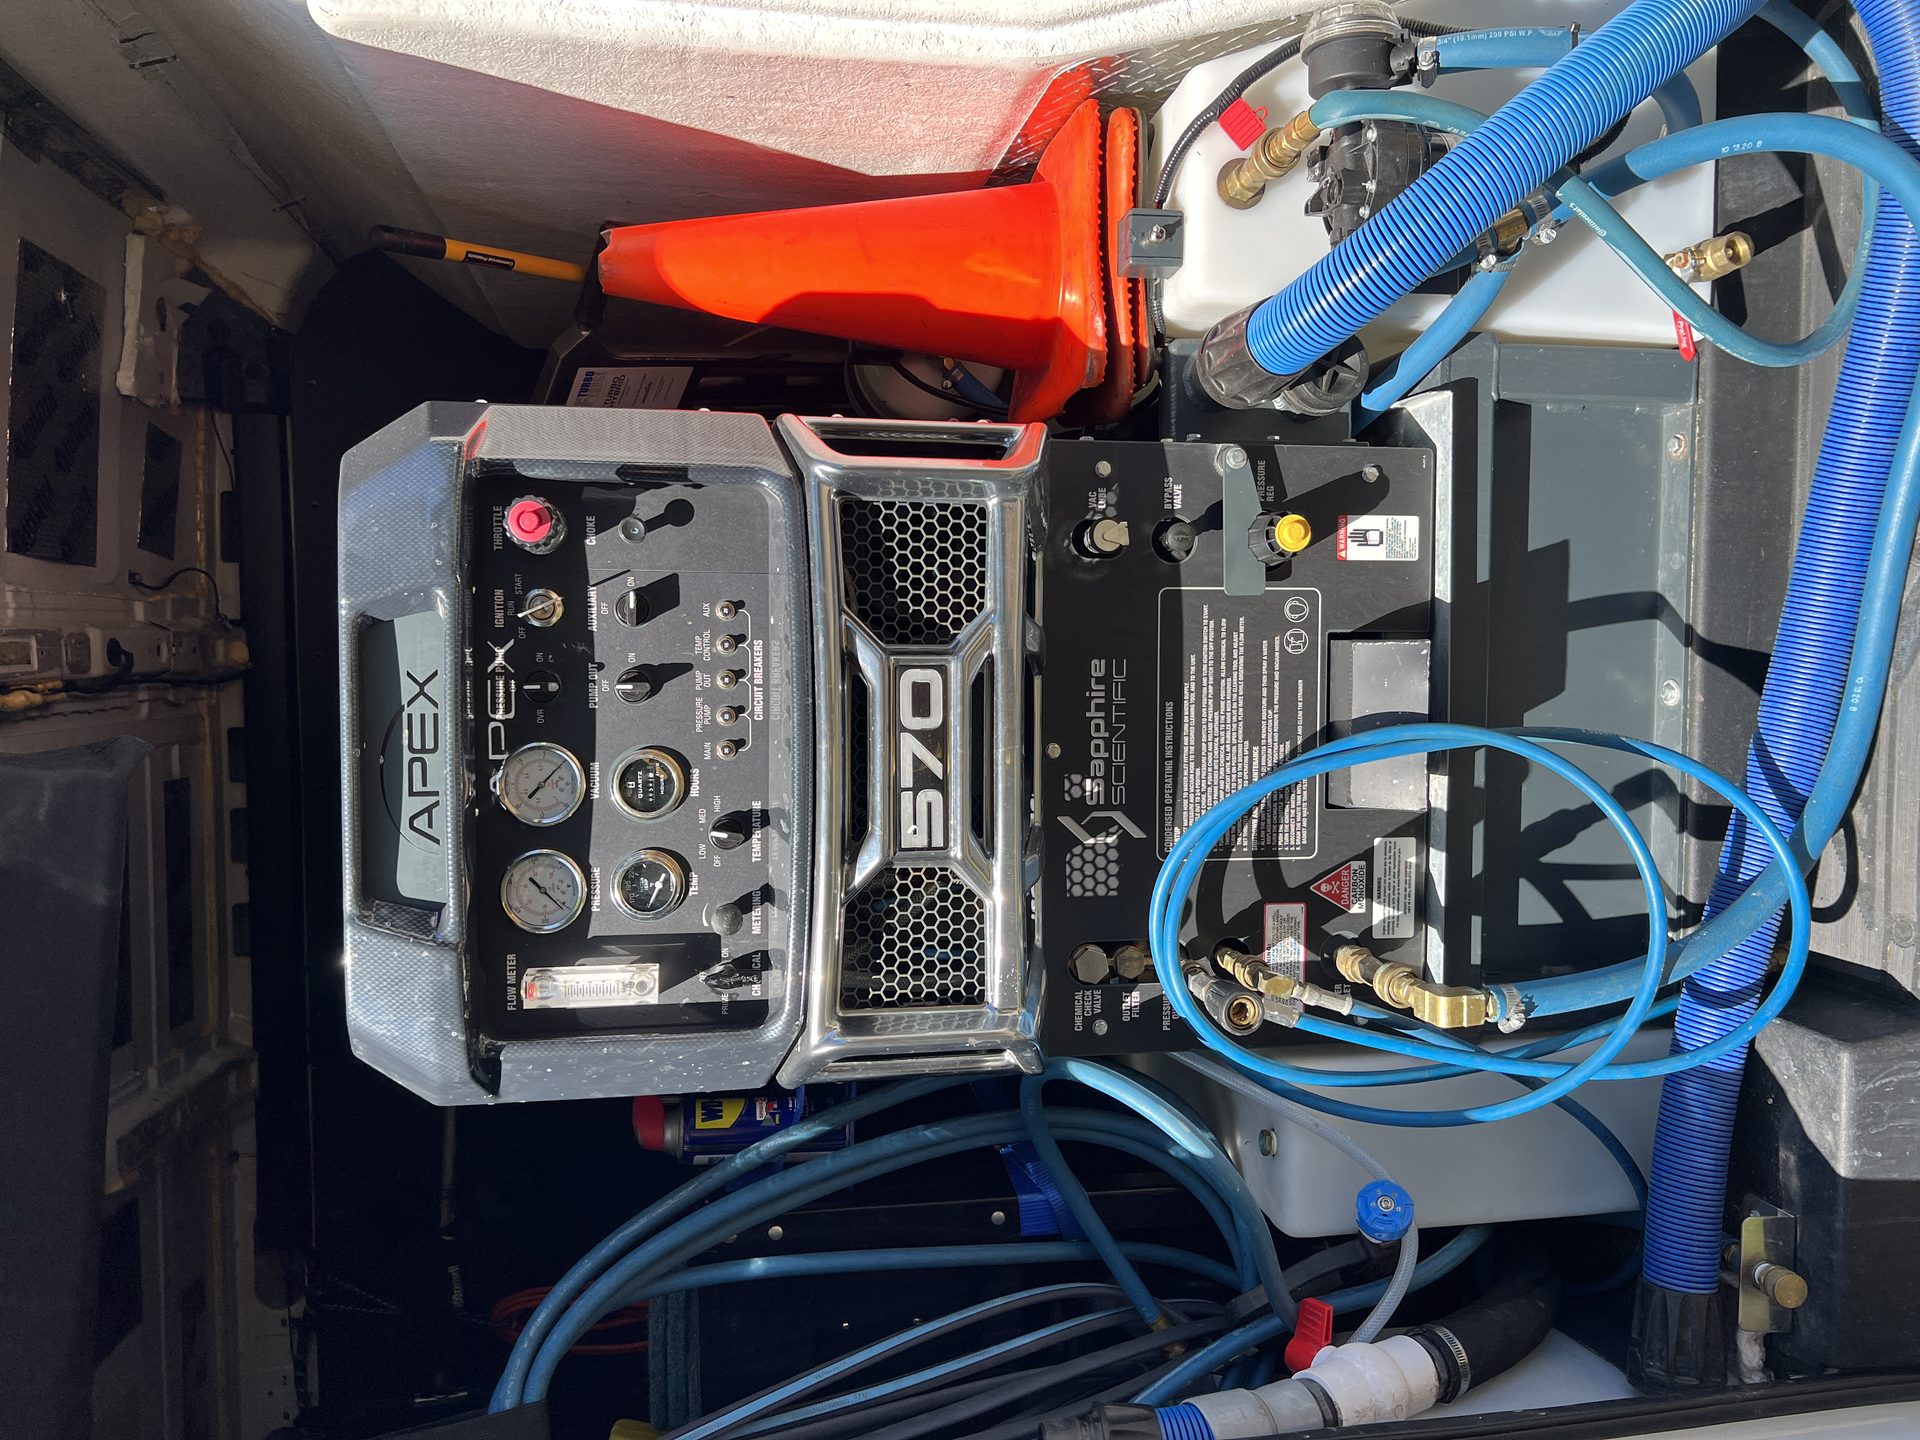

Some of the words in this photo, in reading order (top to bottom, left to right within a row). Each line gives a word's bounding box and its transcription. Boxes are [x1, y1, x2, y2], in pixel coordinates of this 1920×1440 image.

[1489, 30, 1502, 38] 200
[578, 371, 595, 398] TURBO
[603, 376, 619, 406] TURBO
[1164, 477, 1173, 509] BYPASS
[1257, 460, 1266, 501] PRESSURE
[1266, 485, 1274, 502] REG
[1088, 491, 1097, 508] VAC
[1098, 487, 1106, 509] LUBE
[1173, 484, 1182, 509] VALVE
[493, 505, 503, 550] THROTTLE
[586, 516, 596, 545] CHOKE
[515, 573, 523, 595] START
[628, 576, 635, 587] ON
[494, 589, 504, 628] IGNITION
[507, 600, 515, 616] RUN
[588, 584, 597, 632] AUXILIARY
[601, 602, 609, 615] OFF
[495, 646, 505, 672] PUMP
[536, 652, 544, 662] ON
[628, 653, 636, 663] ON
[695, 635, 703, 655] TEMP
[703, 629, 711, 661] CONTROL
[589, 663, 598, 680] OUT
[754, 640, 763, 684] BREAKERS
[495, 676, 505, 720] PRESSURE
[589, 682, 598, 709] PUMP
[754, 686, 763, 720] CIRCUIT
[704, 705, 712, 725] PUMP
[1165, 701, 1174, 758] INSTRUCTIONS
[1086, 658, 1109, 805] Sapphire
[1112, 658, 1126, 805] SCIENTIFIC
[406, 669, 440, 846] APEX
[704, 742, 712, 760] MAIN
[900, 668, 944, 848] 570
[590, 762, 599, 799] VACUUM
[690, 768, 700, 797] HOURS
[1164, 760, 1173, 804] OPERATING
[752, 800, 761, 862] TEMPERATURE
[1164, 806, 1173, 852] CONDENSED
[591, 867, 600, 912] PRESSURE
[689, 872, 698, 896] TEMP
[1340, 869, 1350, 904] DANGER
[752, 891, 761, 934] METERING
[722, 948, 729, 958] ON
[507, 954, 516, 982] METER
[752, 952, 761, 996] CHICAL
[507, 983, 517, 1010] FLOW
[1075, 990, 1083, 1031] CHEMICAL
[1084, 990, 1092, 1016] CHECK
[1093, 990, 1102, 1014] VALVE
[1122, 992, 1130, 1022] OUTLET
[1131, 991, 1140, 1018] FILTER
[1162, 990, 1171, 1031] PRESSUR
